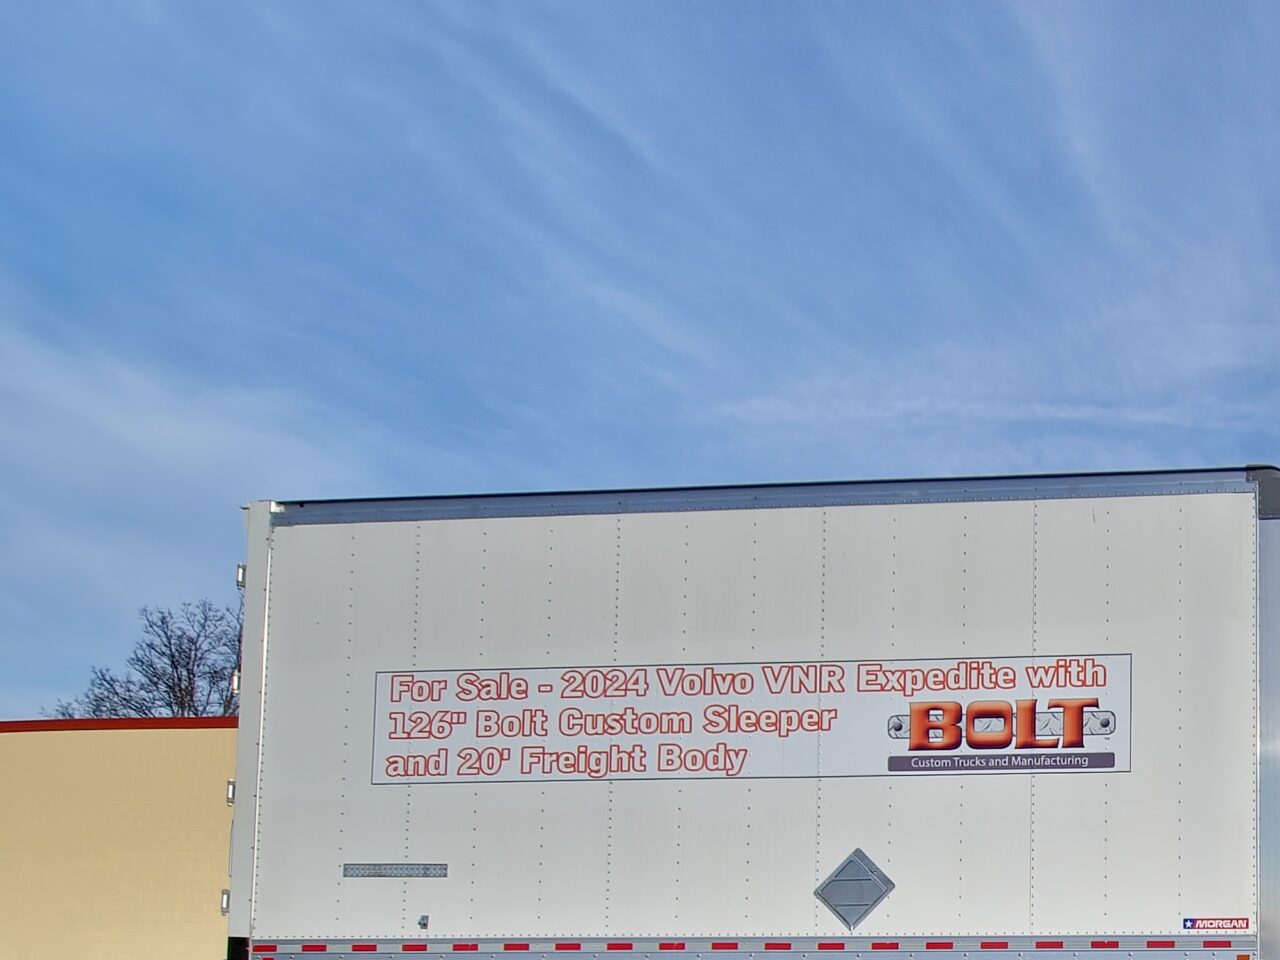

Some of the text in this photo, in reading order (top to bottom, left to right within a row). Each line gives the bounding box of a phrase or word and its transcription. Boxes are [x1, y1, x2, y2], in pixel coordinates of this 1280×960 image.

[390, 675, 447, 702] For
[455, 672, 528, 701] Sale
[560, 669, 649, 699] 2024
[656, 667, 753, 696] Volvo
[762, 664, 845, 694] VNR
[856, 662, 1016, 697] Expedite
[1026, 658, 1107, 688] with
[388, 704, 838, 740] 126" Bolt Custom Sleeper
[908, 698, 1100, 751] BOLT
[385, 743, 748, 778] and 20' Freight Body
[911, 755, 1089, 768] Custom Trucks and Manufacturing
[1195, 919, 1247, 929] MORGAN
